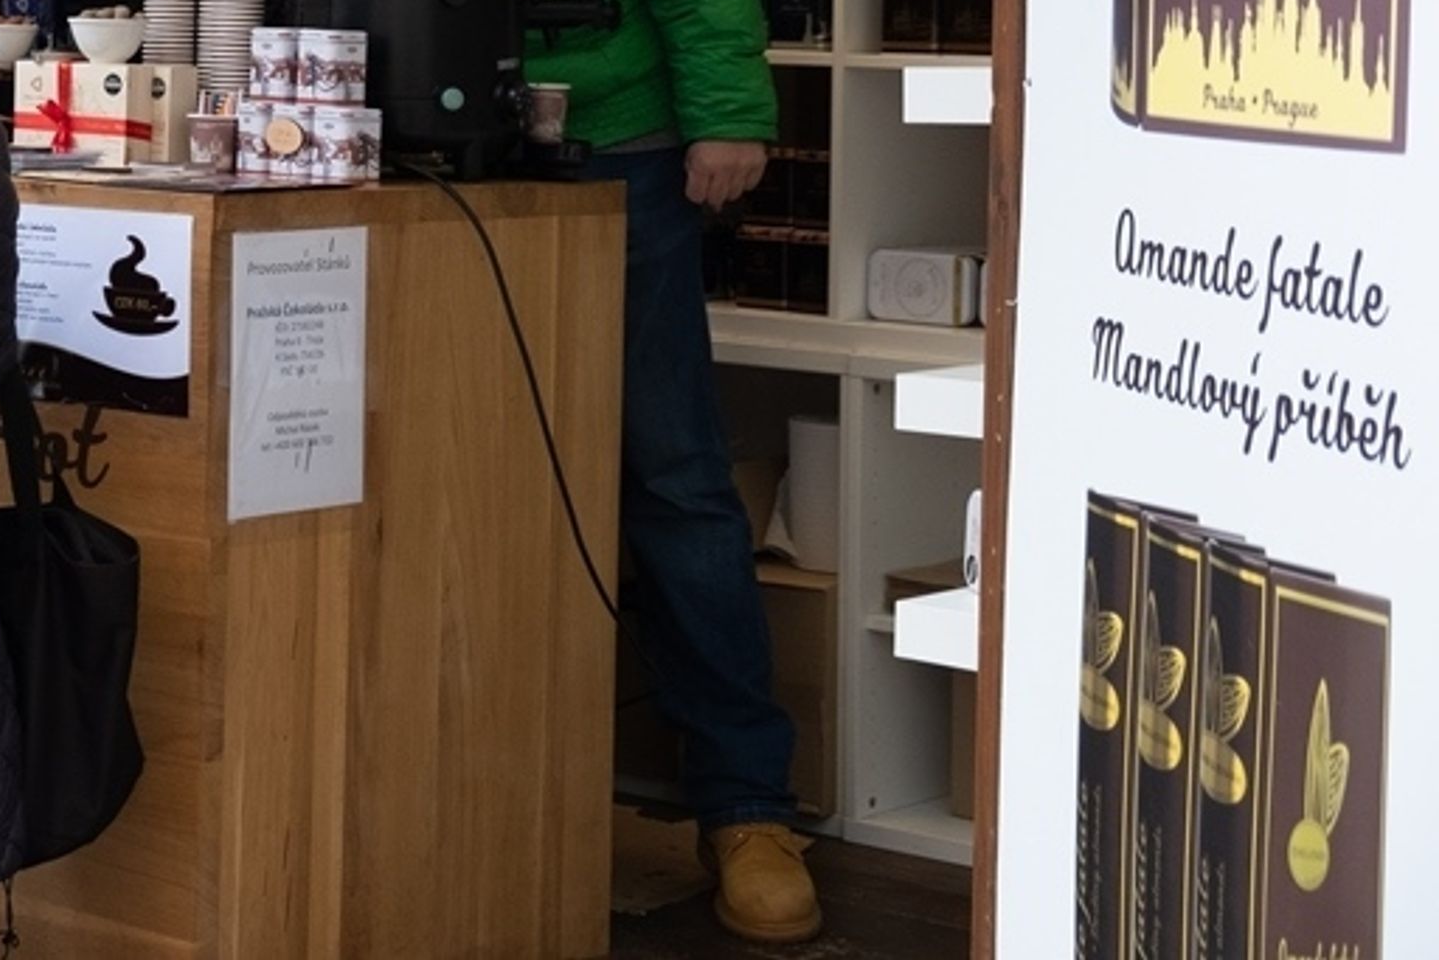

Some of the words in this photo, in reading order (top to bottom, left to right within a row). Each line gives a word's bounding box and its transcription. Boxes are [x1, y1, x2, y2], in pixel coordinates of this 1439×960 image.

[1202, 84, 1246, 113] Praha
[1261, 88, 1319, 128] Prague
[1114, 208, 1259, 300] Amande
[1258, 235, 1389, 334] fatale
[1092, 316, 1266, 454] Mandlový
[1267, 368, 1412, 470] příběh
